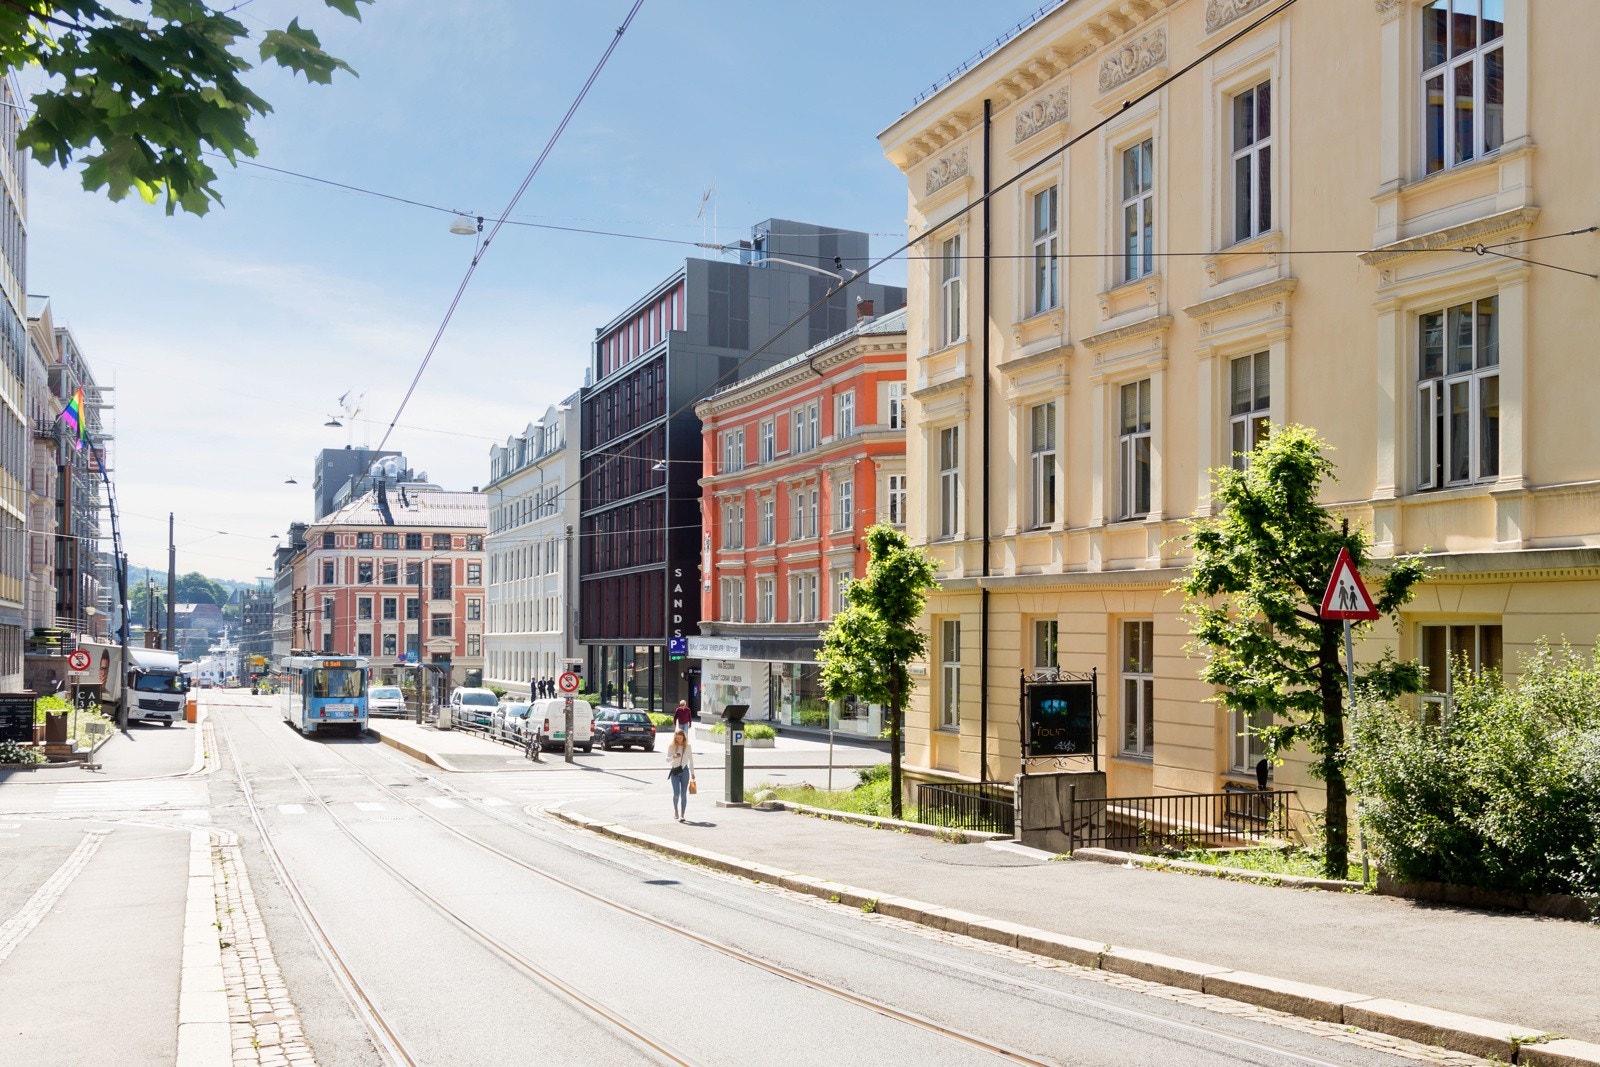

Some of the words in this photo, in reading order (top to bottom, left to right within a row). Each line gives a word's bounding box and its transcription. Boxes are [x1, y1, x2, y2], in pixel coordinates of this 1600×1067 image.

[673, 568, 683, 638] SANDS
[670, 639, 677, 649] P
[735, 732, 743, 743] P
